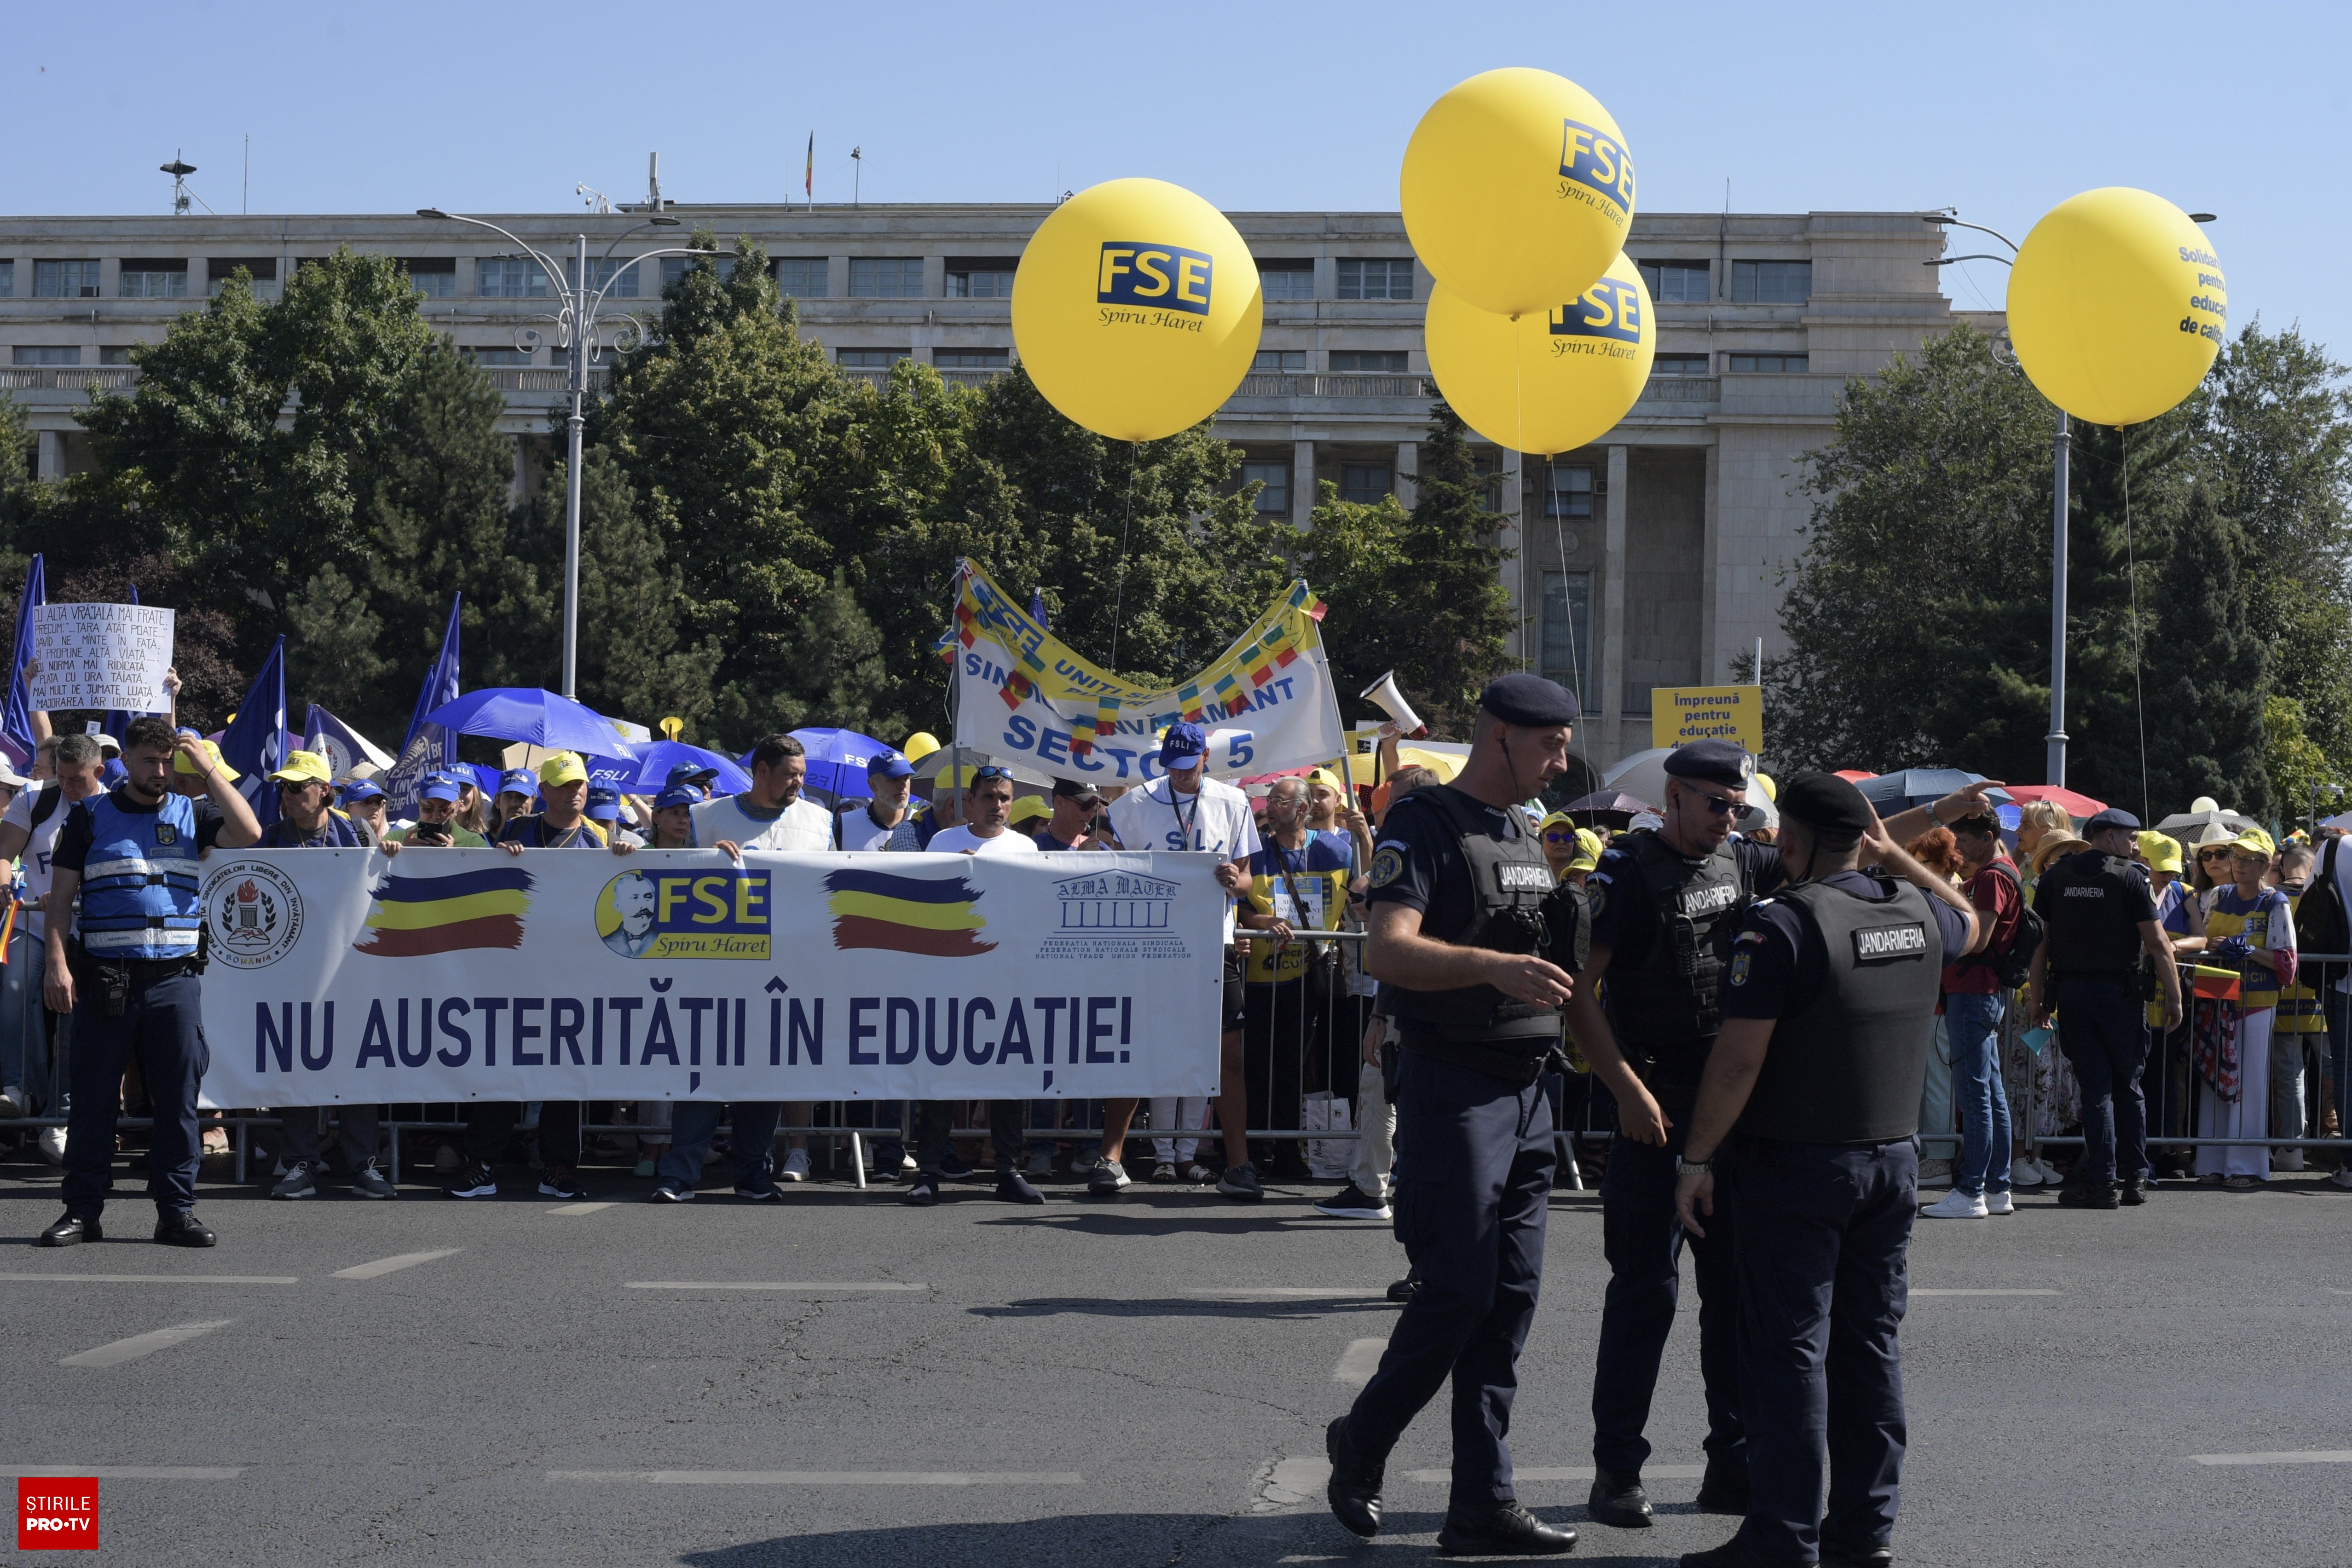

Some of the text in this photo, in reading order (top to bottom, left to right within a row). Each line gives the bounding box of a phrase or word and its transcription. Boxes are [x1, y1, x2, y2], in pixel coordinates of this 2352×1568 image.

[1563, 126, 1632, 204] FSE
[1556, 181, 1624, 228] Spiru Haret
[1099, 249, 1210, 304] FSE
[2198, 272, 2225, 292] pentru
[1098, 307, 1205, 332] Spiru Haret
[2179, 316, 2198, 334] de
[1550, 339, 1637, 360] Spiru Haret
[34, 609, 43, 622] CU
[35, 634, 53, 648] DAVID
[62, 635, 71, 645] NE
[82, 633, 107, 645] MINTE
[117, 634, 126, 646] ÎN
[46, 648, 82, 659] PROPUNE
[36, 660, 44, 673] CU
[48, 660, 75, 671] NORMA
[83, 659, 98, 670] MAI
[40, 673, 58, 684] PLATA
[65, 672, 76, 682] CU
[84, 671, 103, 682] ORA
[33, 685, 46, 697] MAI
[50, 684, 67, 695] MULT
[71, 684, 81, 694] DE
[36, 696, 84, 708] MAJORAREA
[91, 694, 106, 706] IAR
[1674, 692, 1739, 707] Împreună
[1685, 710, 1730, 723] pentru
[1679, 723, 1737, 738] educație
[1003, 715, 1254, 781] SECTO 5
[1170, 740, 1190, 750] FSLI
[844, 753, 870, 768] FS
[589, 769, 630, 781] FSLI
[202, 865, 245, 902] SINDICATELOR
[251, 865, 279, 880] LIBERE
[280, 880, 293, 895] DIN
[1057, 876, 1177, 898] ALMA MATER
[658, 876, 768, 924] FSE
[1684, 885, 1737, 913] ANDARMERIA
[2063, 886, 2104, 898] JANDARMERIA
[657, 936, 768, 957] Spiru Haret
[1860, 927, 1926, 954] JANDARMERIA
[226, 954, 272, 965] ROMÂNIA
[256, 975, 1132, 1094] NU AUSTERITĂȚII ÎN EDUCAȚIE!
